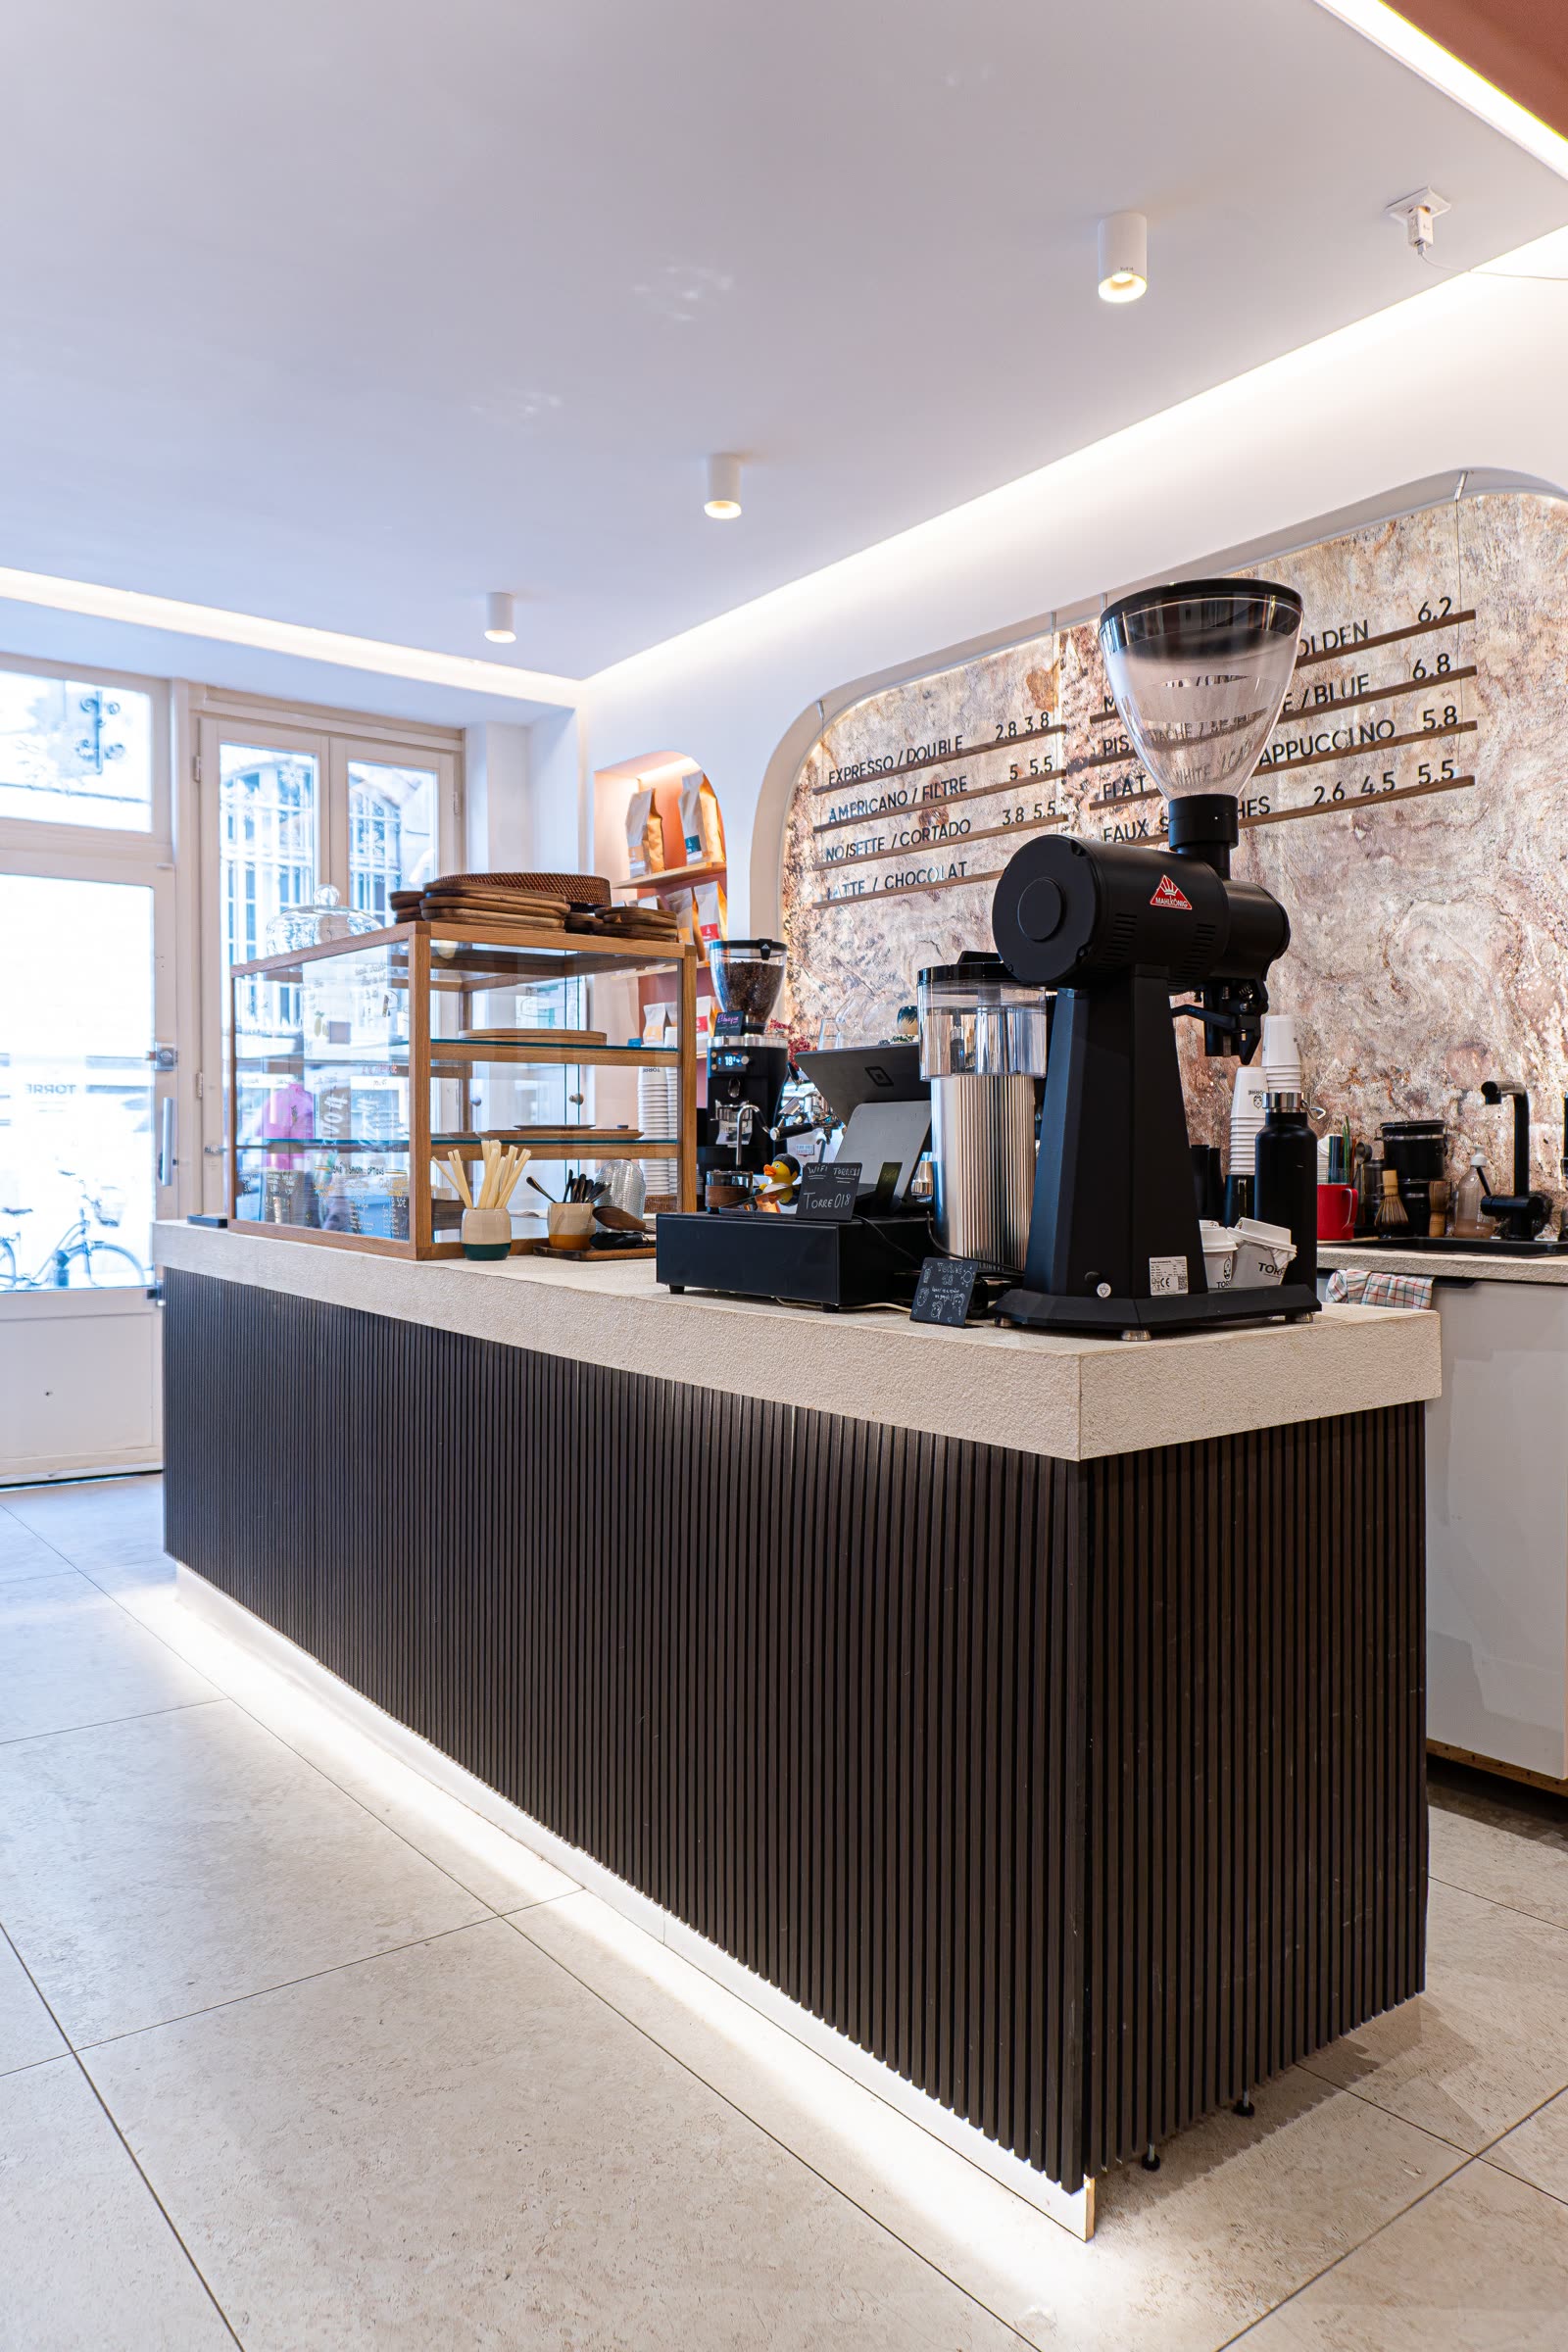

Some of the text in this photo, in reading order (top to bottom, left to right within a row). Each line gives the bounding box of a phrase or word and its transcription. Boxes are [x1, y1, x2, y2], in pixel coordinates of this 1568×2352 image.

[1298, 596, 1452, 658] OLDEN 6.2
[1314, 673, 1370, 705] BLUE
[1413, 653, 1451, 679] 6.8
[829, 756, 894, 784] EXPRESSO
[906, 735, 963, 764] DOUBLE
[996, 721, 1017, 741] 2.8
[1025, 711, 1050, 734] 3.8
[1103, 774, 1147, 800] FLAT
[1259, 719, 1396, 766] APPUCCINO
[1423, 706, 1458, 731] 5.8
[829, 791, 908, 823] AMERICANO
[923, 776, 968, 802] FILTRE
[1009, 764, 1018, 780] 5
[1030, 756, 1053, 776] 5.5
[1314, 781, 1346, 807] 2.6
[1361, 771, 1396, 795] 4.5
[1418, 759, 1454, 785] 5.5
[825, 837, 885, 862] NOISETTE
[900, 819, 971, 847] CORTADO
[1003, 807, 1025, 826] 3.8
[1034, 801, 1056, 819] 5.5
[827, 880, 865, 901] LATTE
[885, 861, 968, 890] CHOCOLAT
